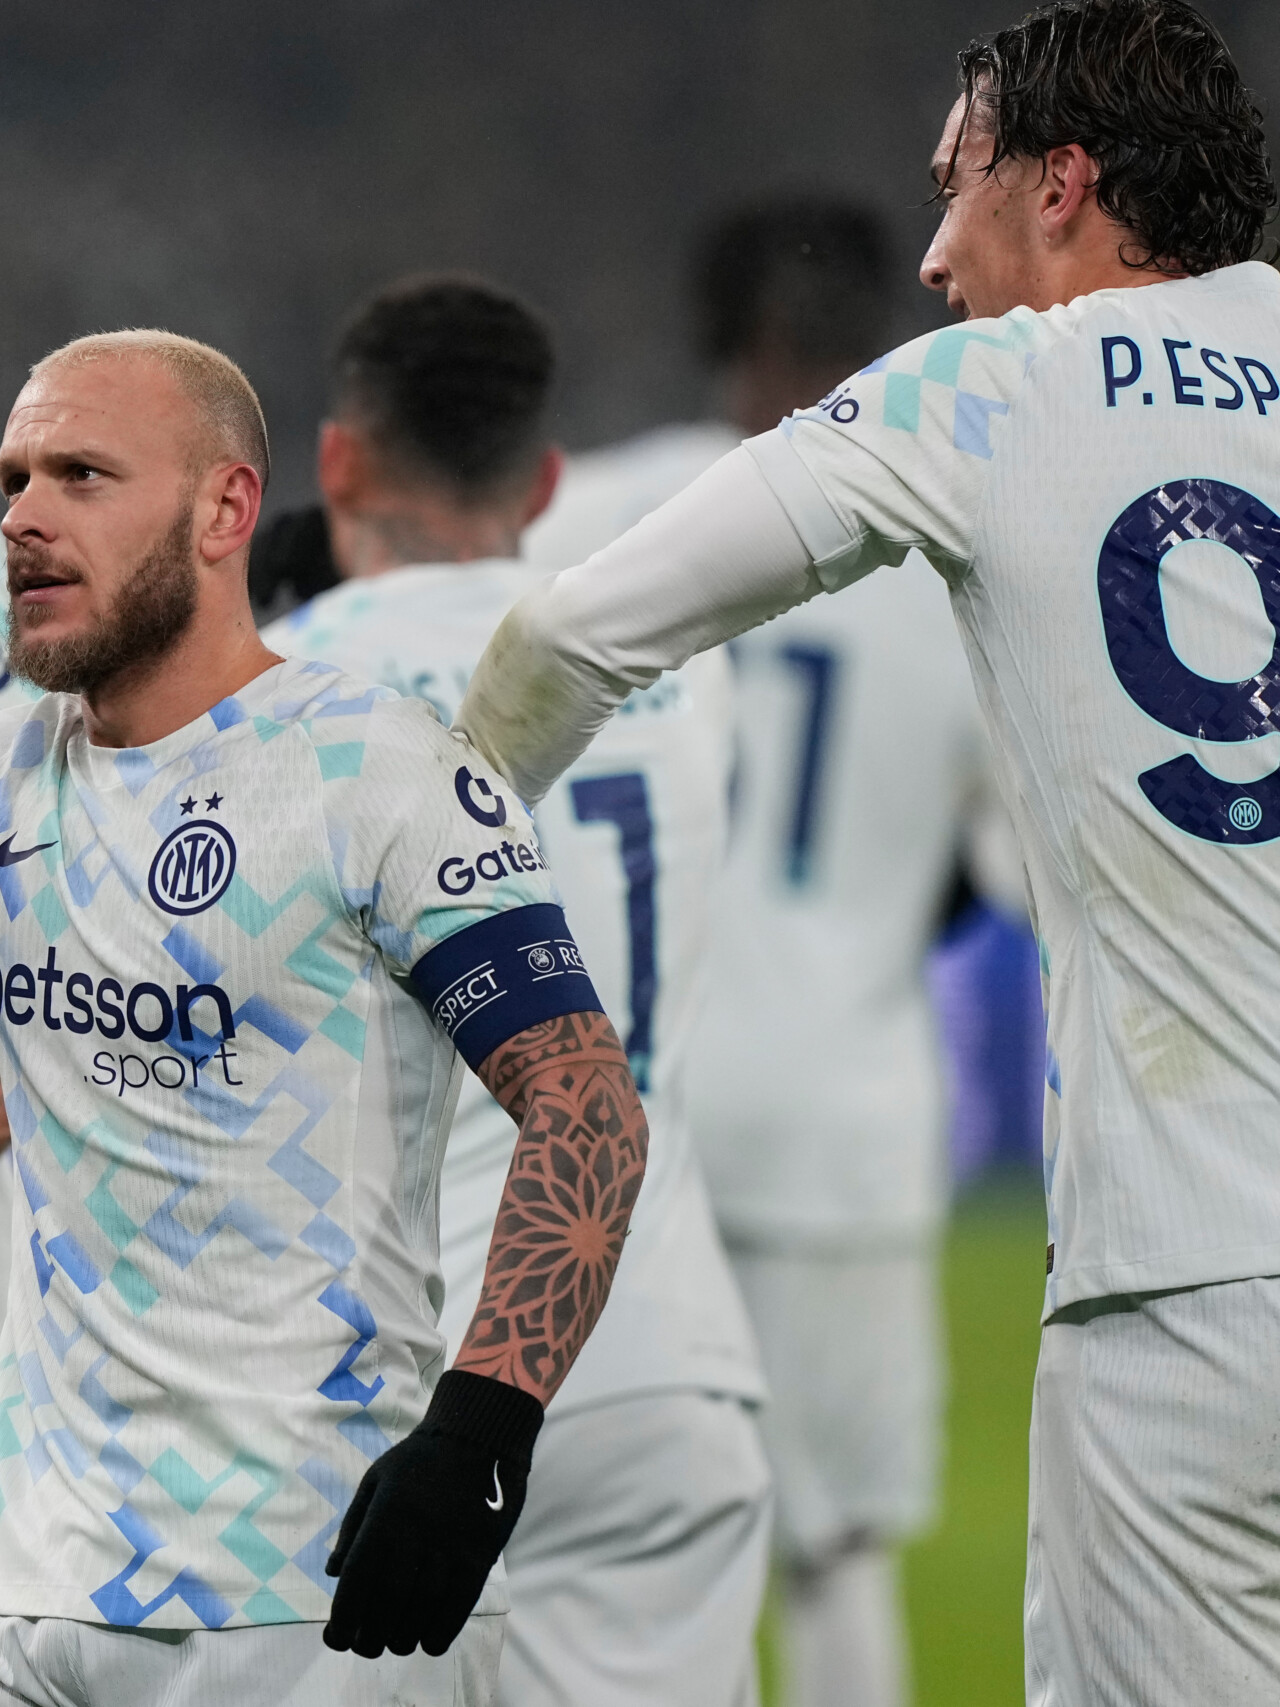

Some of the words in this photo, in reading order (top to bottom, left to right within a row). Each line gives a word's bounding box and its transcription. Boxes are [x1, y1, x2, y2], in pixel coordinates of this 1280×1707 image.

[1096, 477, 1280, 847] 9
[437, 840, 552, 896] Gate.i
[558, 946, 584, 967] RE
